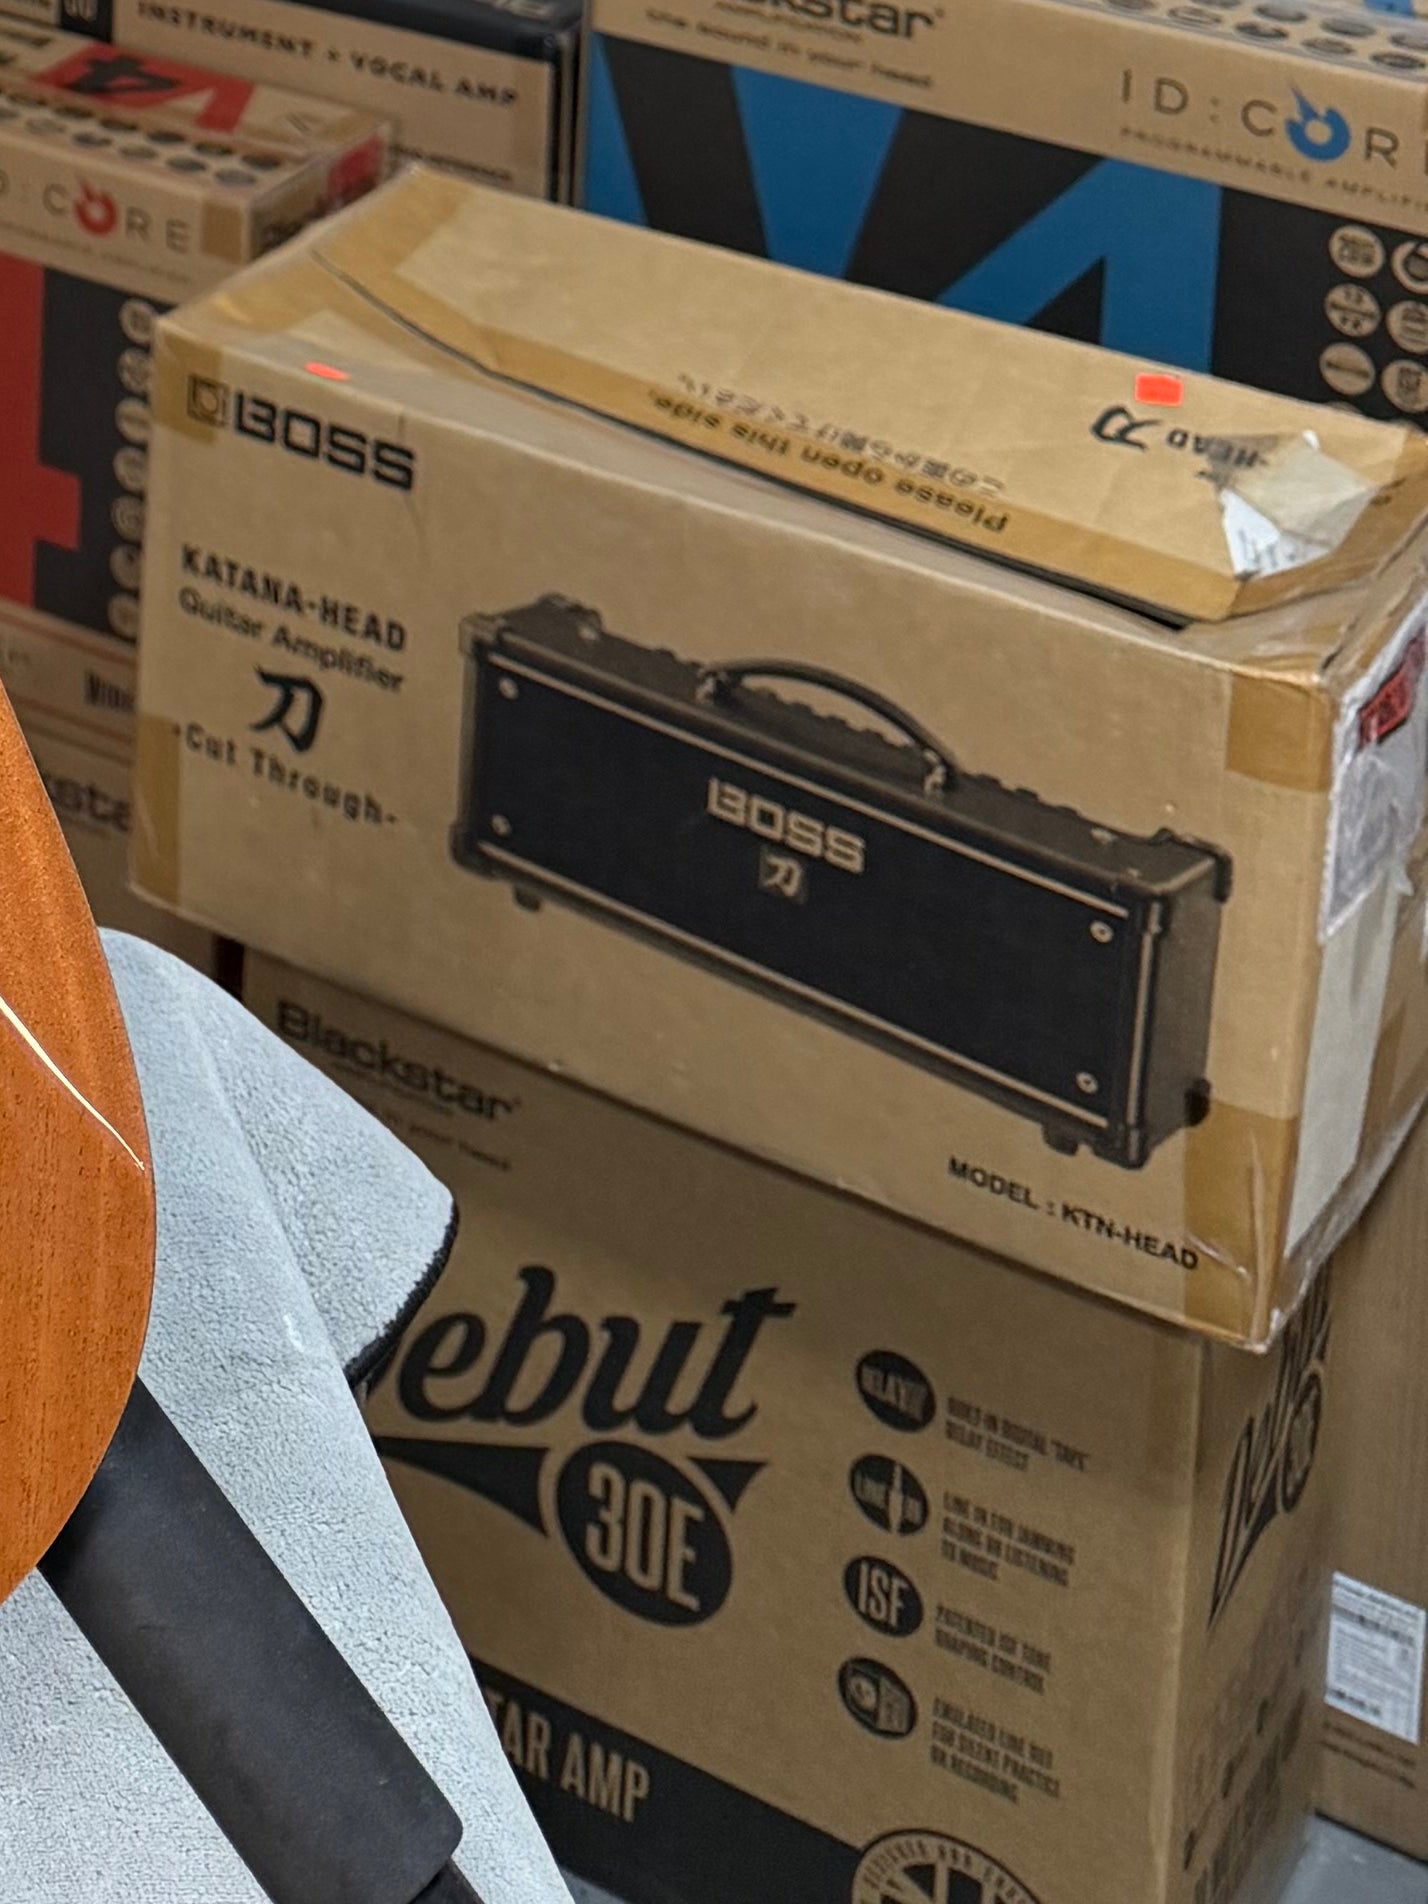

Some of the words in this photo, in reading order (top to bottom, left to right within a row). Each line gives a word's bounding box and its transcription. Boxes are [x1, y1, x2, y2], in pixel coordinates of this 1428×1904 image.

[136, 0, 314, 60] INSTRUMENT
[350, 49, 445, 93] VOCAL
[453, 77, 520, 106] AMP
[233, 389, 416, 492] BOSS
[730, 422, 790, 459] this
[798, 443, 886, 486] open
[893, 476, 1011, 535] Please
[178, 586, 263, 640] Guitar
[270, 621, 405, 693] Amplifier
[180, 542, 407, 653] KATANA-HEAD
[249, 663, 325, 754] 刀
[706, 774, 867, 875] BOSS
[276, 999, 515, 1121] Blackstar
[947, 1153, 1042, 1211] MODEL
[1061, 1201, 1200, 1271] KTN-HEAD
[366, 1264, 799, 1440] ebut
[584, 1460, 705, 1613] 30E
[857, 1559, 910, 1629] ISF
[559, 1733, 652, 1825] AMP
